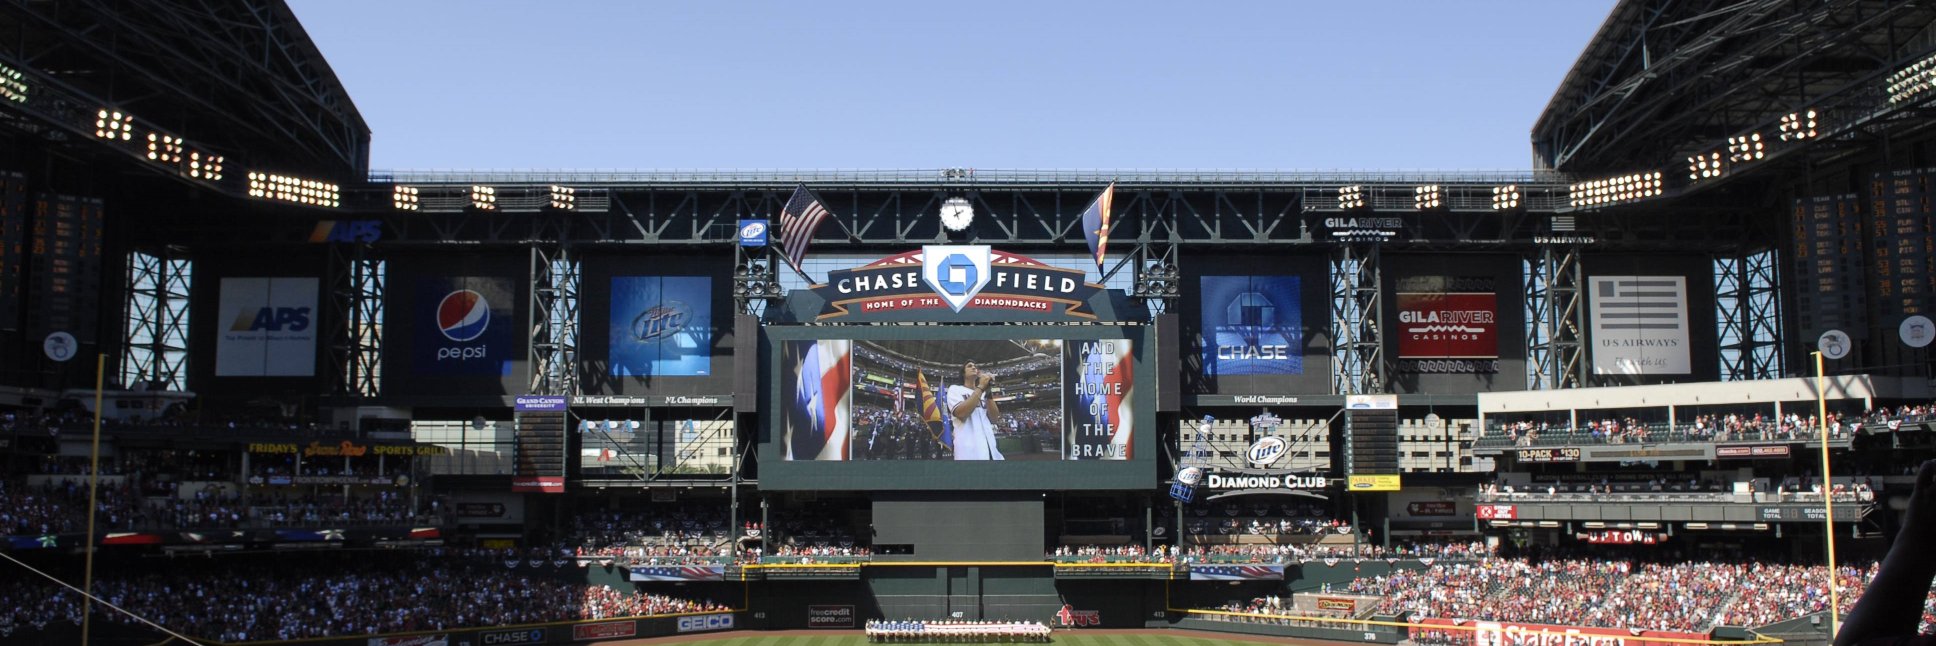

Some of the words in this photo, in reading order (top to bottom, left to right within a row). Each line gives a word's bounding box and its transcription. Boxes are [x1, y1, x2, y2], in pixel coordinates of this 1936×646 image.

[1325, 217, 1358, 228] GILA
[1358, 217, 1401, 228] RIVER
[327, 219, 383, 243] APS
[837, 272, 918, 294] CHASE
[997, 272, 1076, 294] FIELD
[866, 300, 895, 310] HOME
[901, 299, 914, 307] OF
[920, 298, 939, 307] THE
[975, 298, 1047, 310] DIAMONDBACKS
[249, 307, 311, 331] APS
[1399, 311, 1440, 323] GILA
[1440, 311, 1494, 323] RIVER
[640, 312, 684, 340] Lite
[437, 344, 486, 361] pepsi
[1081, 342, 1115, 354] AND
[1217, 345, 1288, 360] CHASE
[1083, 362, 1114, 375] THE
[1075, 383, 1122, 395] HOME
[586, 396, 603, 404] West
[604, 396, 645, 405] Champions
[677, 396, 718, 405] Champions
[1257, 396, 1298, 404] Champions
[1089, 403, 1109, 416] OF
[1083, 424, 1115, 436] THE
[248, 443, 298, 454] FRIDAY'S
[373, 445, 414, 456] SPORTS
[416, 446, 446, 457] GRILL
[1072, 444, 1127, 457] BRAVE
[1255, 443, 1282, 461] Lite
[1518, 449, 1552, 458] 10-PACK
[1561, 448, 1579, 457] $130
[1208, 475, 1280, 488] DIAMOND
[1285, 474, 1326, 488] CLUB
[1589, 530, 1653, 542] UPTOWN
[1153, 610, 1165, 618] 413
[680, 616, 734, 629] GEICO
[484, 631, 529, 645] CHASE
